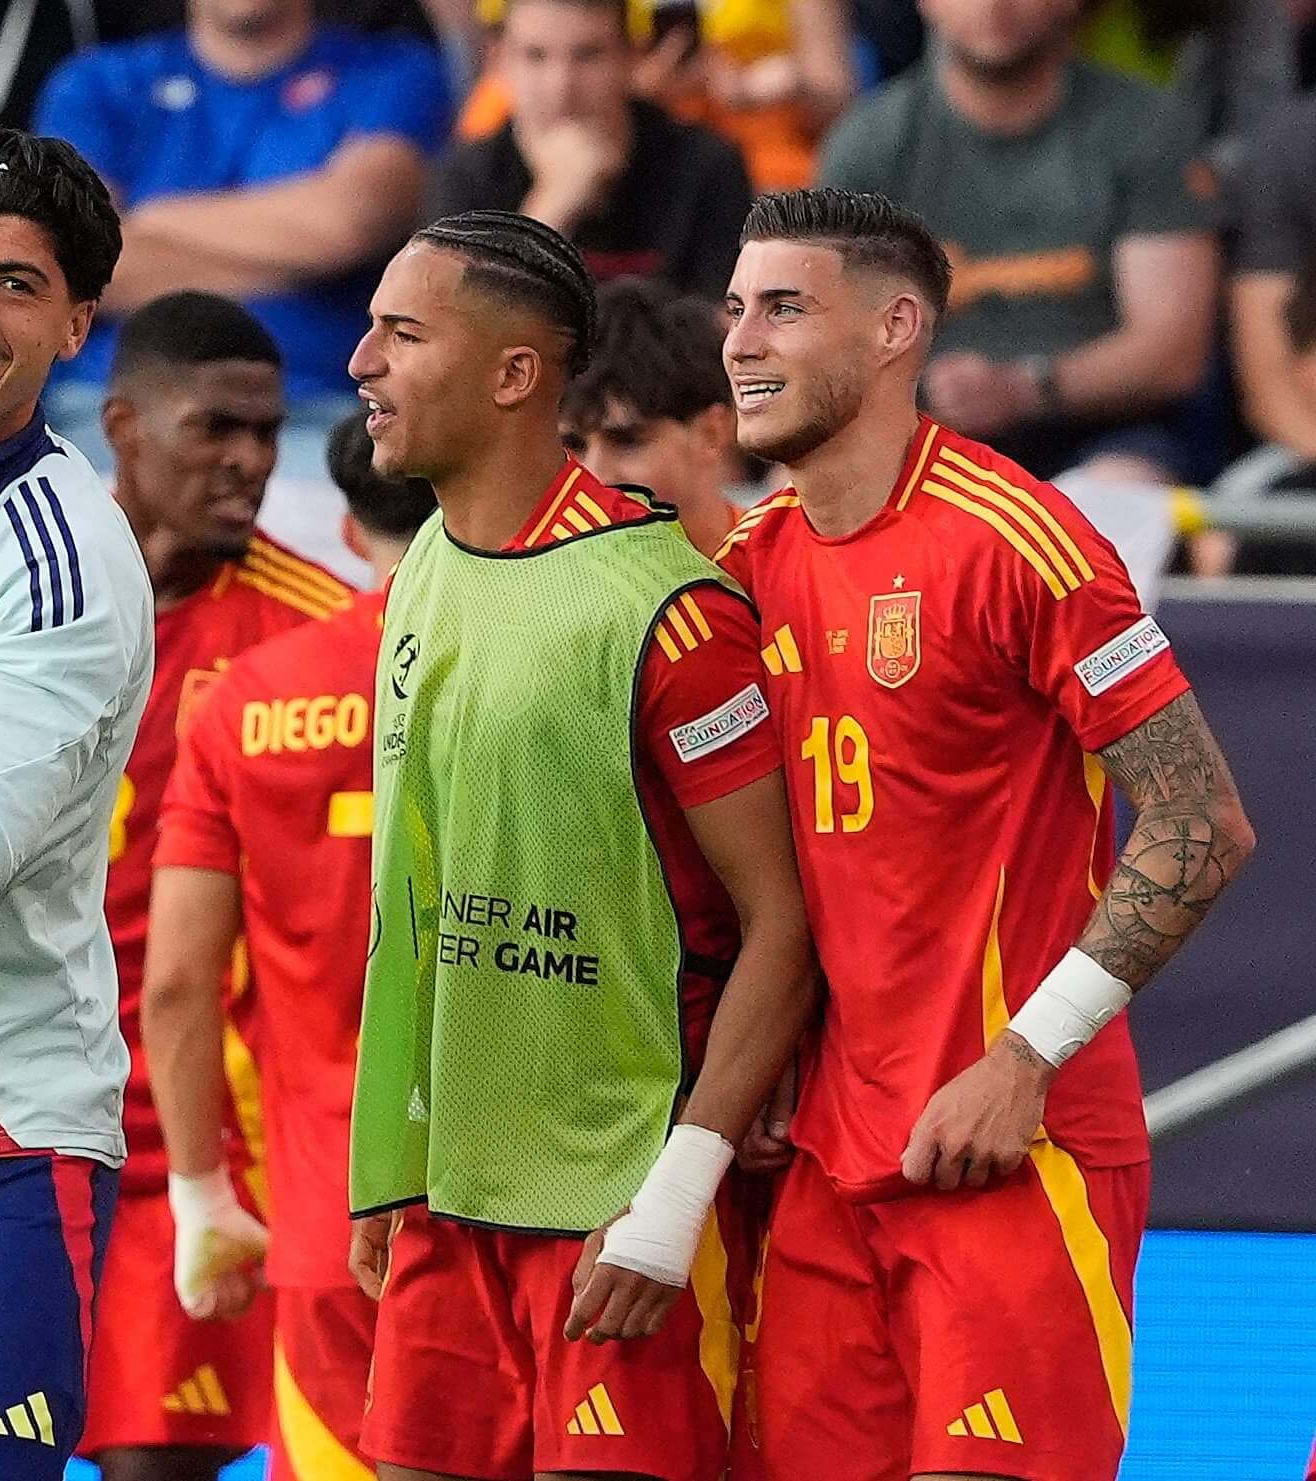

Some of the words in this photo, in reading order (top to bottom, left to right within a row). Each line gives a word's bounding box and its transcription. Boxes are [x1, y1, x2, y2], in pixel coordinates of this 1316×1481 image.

[1082, 625, 1160, 685] FOUNDATION
[241, 692, 369, 757] DIEGO
[677, 694, 764, 750] FOUNDATION
[801, 715, 874, 833] 19
[440, 884, 512, 929] NER
[522, 903, 578, 943] AIR
[439, 933, 480, 971] ER
[495, 942, 599, 985] GAME
